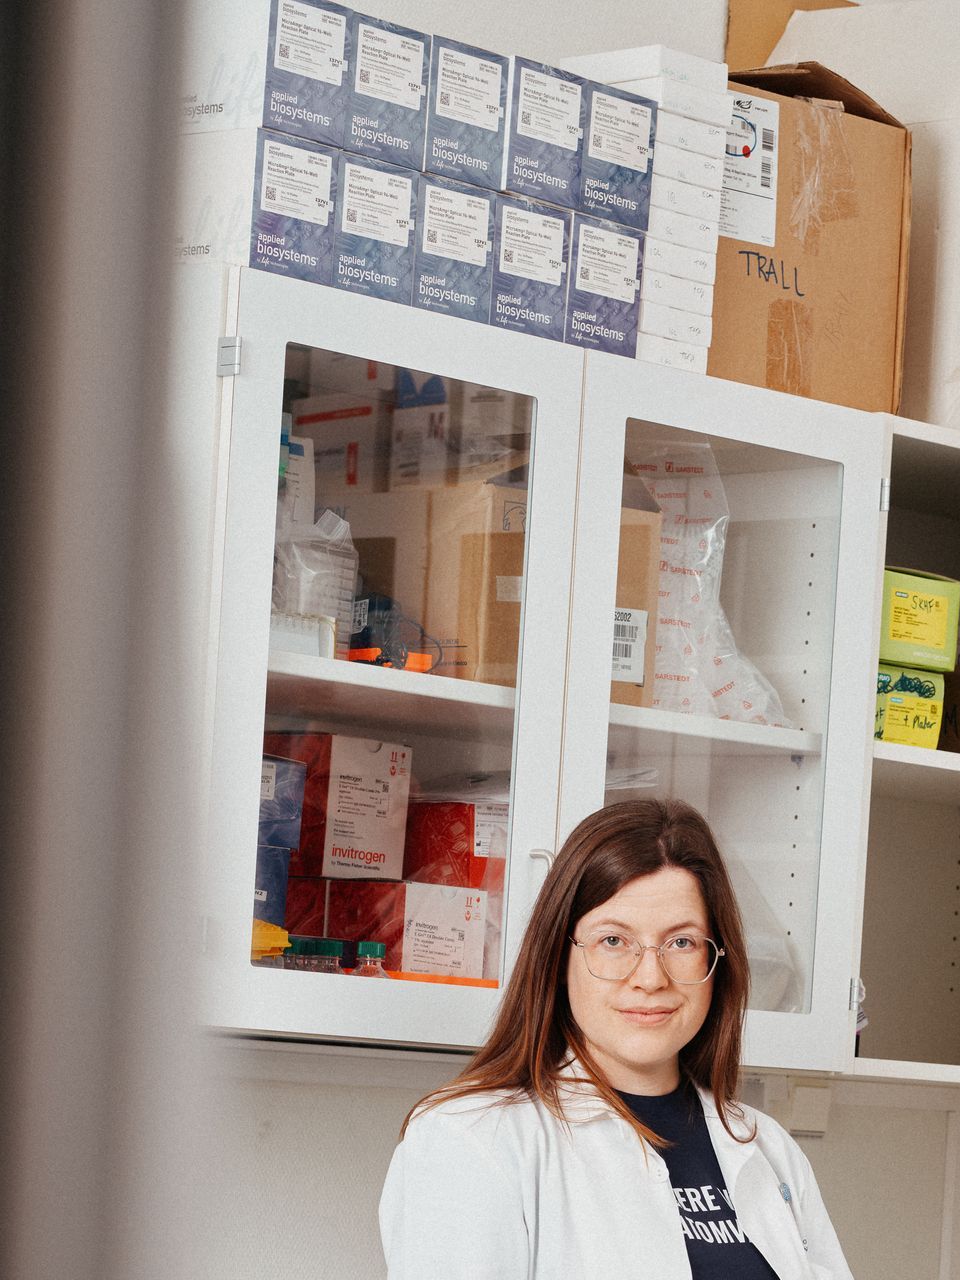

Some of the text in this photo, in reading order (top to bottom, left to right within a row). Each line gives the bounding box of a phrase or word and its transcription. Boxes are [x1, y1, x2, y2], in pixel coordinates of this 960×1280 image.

[270, 91, 299, 105] applied
[270, 100, 331, 127] biosystems
[352, 116, 379, 130] applied
[351, 125, 410, 151] biosystems
[433, 137, 459, 150] applied
[432, 145, 488, 172] biosystems
[514, 156, 540, 169] applied
[513, 164, 568, 190] biosystems
[585, 178, 610, 191] applied
[585, 186, 638, 211] biosystems
[258, 232, 286, 245] applied
[257, 240, 317, 267] biosystems
[339, 254, 366, 267] applied
[338, 263, 397, 287] biosystems
[419, 274, 446, 287] applied
[738, 250, 805, 296] TRALL
[419, 283, 476, 307] biosystems
[496, 293, 522, 306] applied
[495, 302, 551, 326] biosystems
[572, 310, 597, 322] applied
[571, 318, 624, 342] biosystems
[655, 673, 690, 682] SARSTEDT
[332, 844, 386, 864] invitrogen
